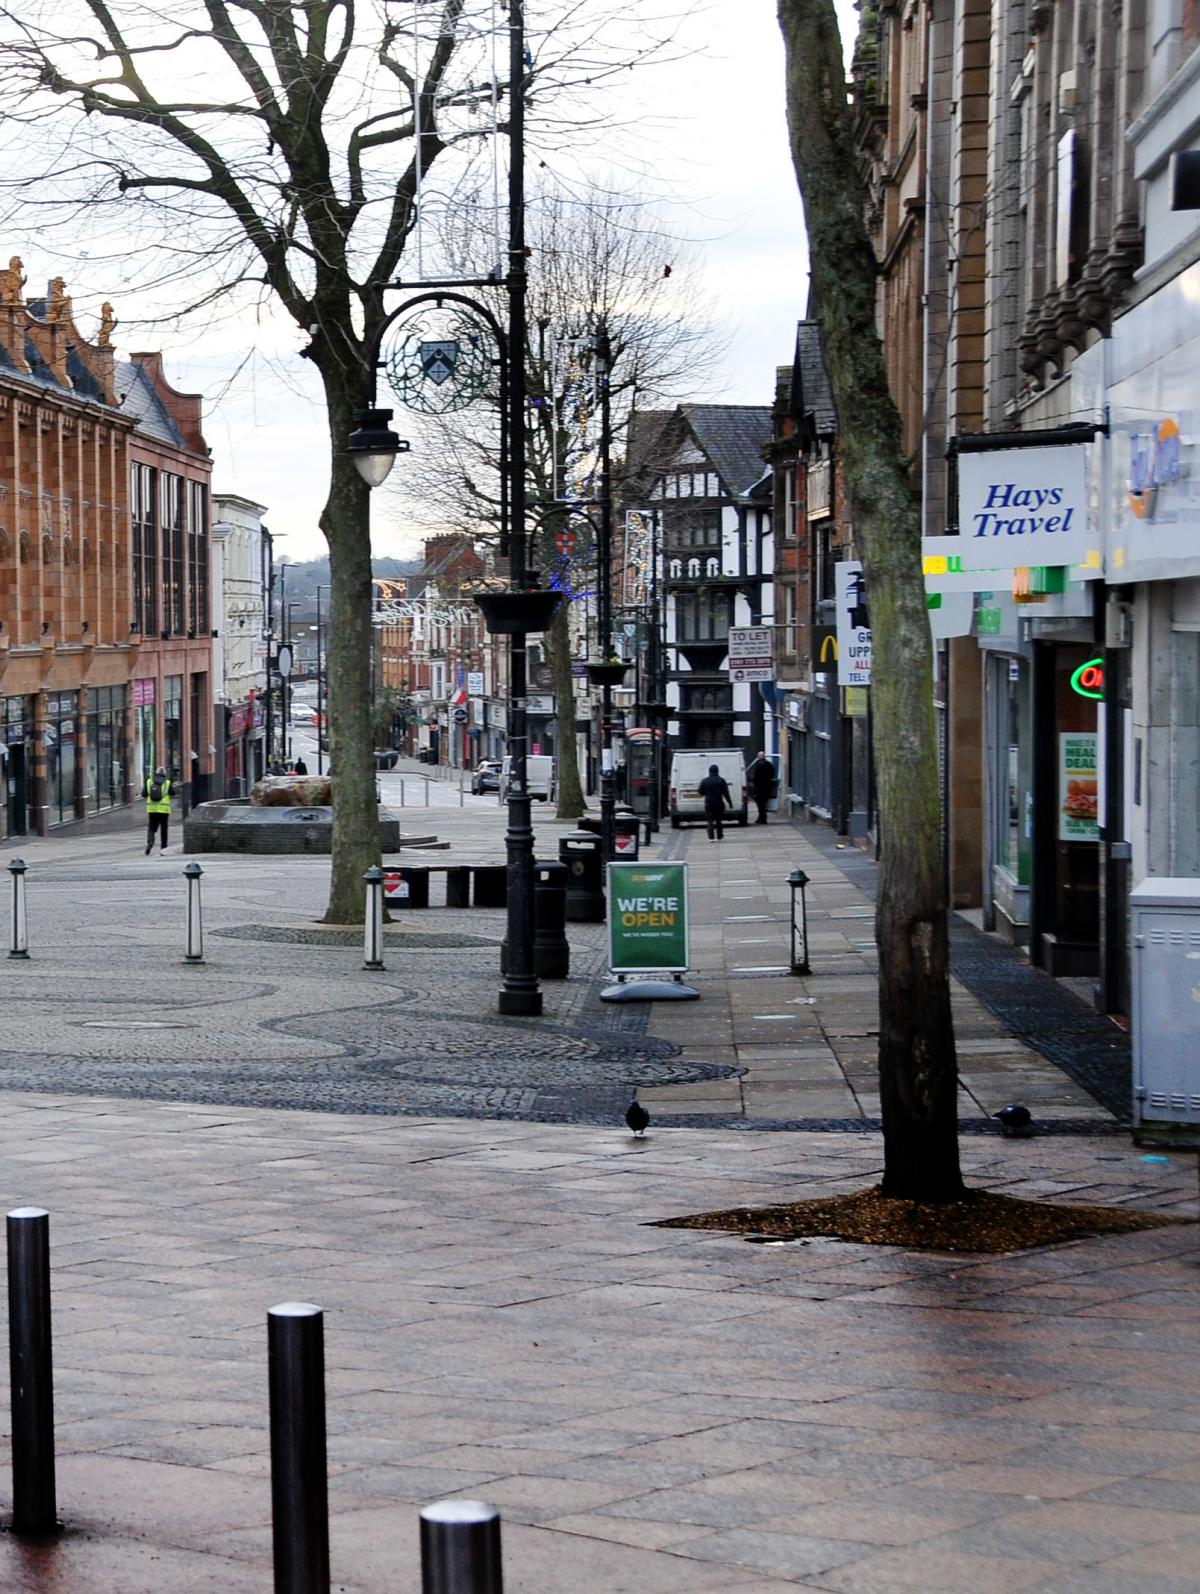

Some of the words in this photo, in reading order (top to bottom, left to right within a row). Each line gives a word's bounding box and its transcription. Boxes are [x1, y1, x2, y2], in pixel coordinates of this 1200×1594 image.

[983, 483, 1063, 512] Hays
[973, 508, 1074, 538] Travel
[731, 632, 746, 641] TO
[749, 631, 769, 641] LET
[1065, 748, 1097, 757] MEAL
[1065, 758, 1097, 768] DEAL
[617, 897, 678, 911] WE'RE
[622, 913, 675, 927] OPEN
